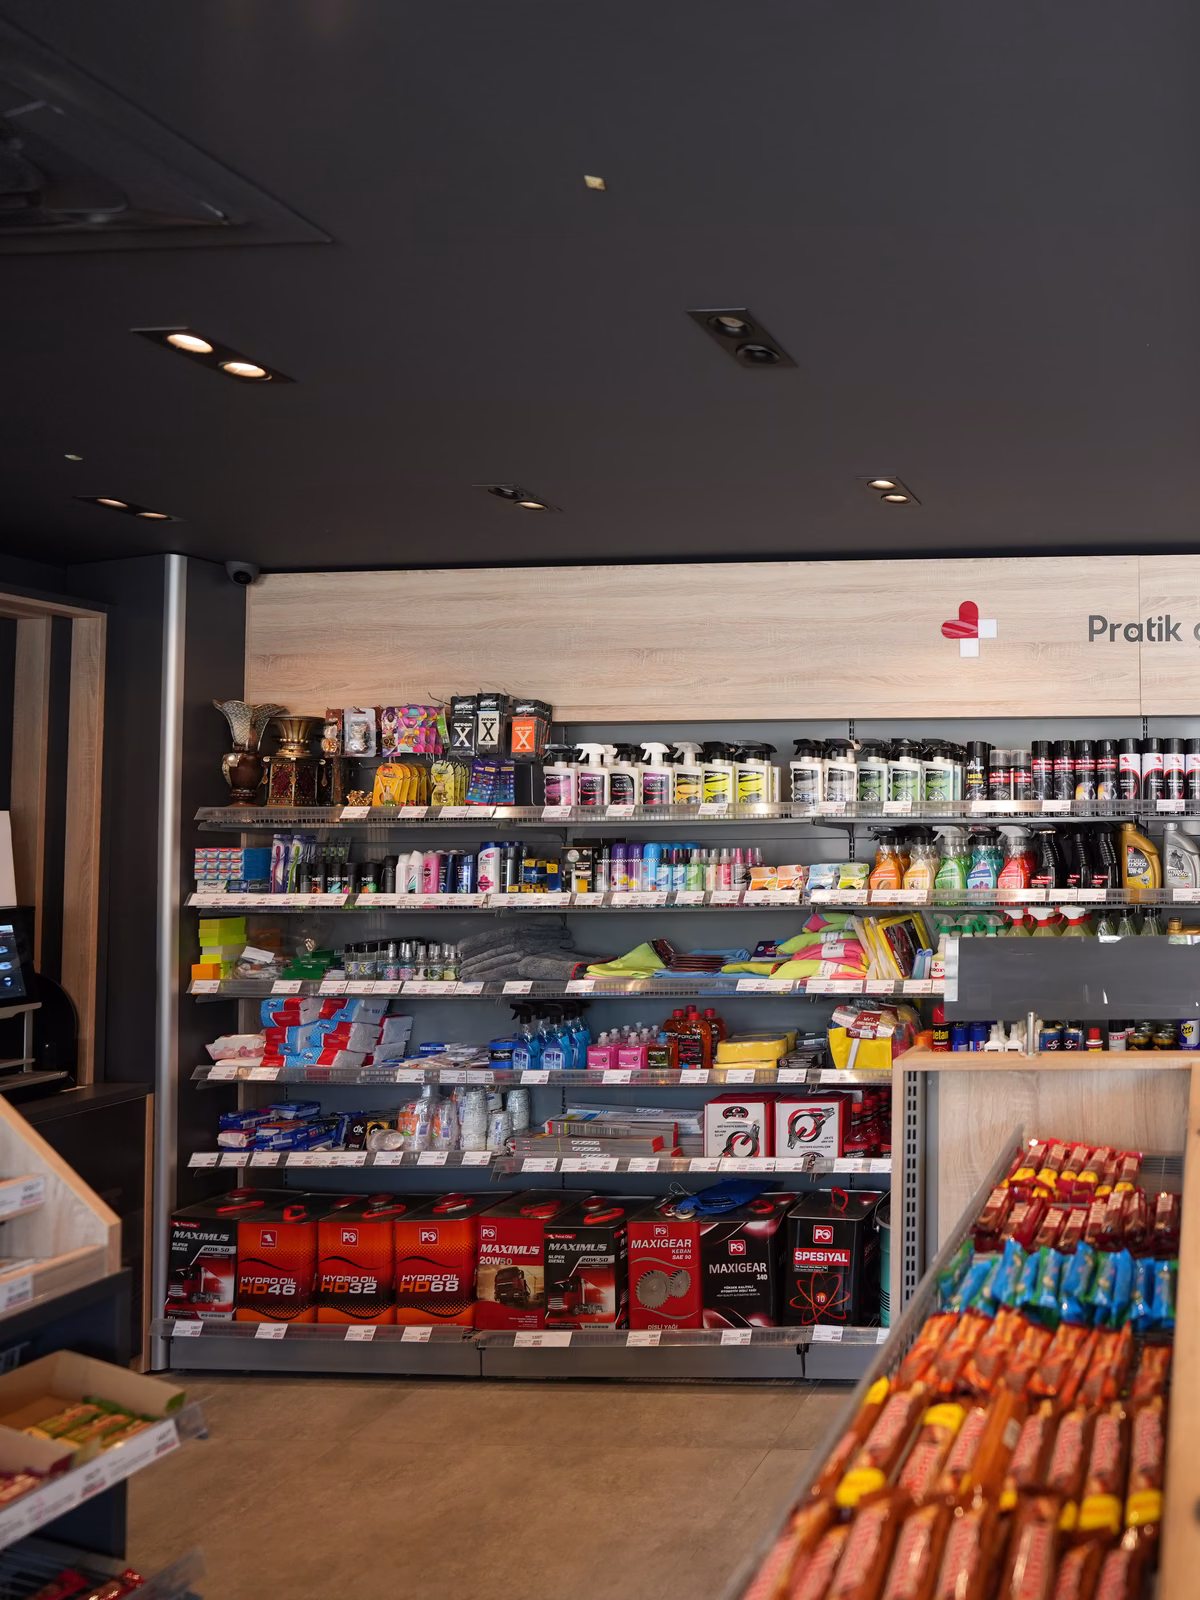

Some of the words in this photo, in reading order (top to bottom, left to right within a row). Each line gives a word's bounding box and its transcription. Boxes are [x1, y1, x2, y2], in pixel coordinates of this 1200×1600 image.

[1088, 614, 1182, 642] Pratik
[454, 727, 472, 746] X
[480, 722, 496, 742] X
[514, 730, 532, 750] X
[932, 1030, 948, 1040] detan
[172, 1230, 230, 1242] MAXIMUS
[480, 1244, 540, 1255] MAXIMUS
[548, 1243, 607, 1252] MAXIMUS
[630, 1239, 692, 1249] MAXIGEAR
[479, 1256, 512, 1265] 20W50
[709, 1263, 767, 1274] MAXIGEAR
[238, 1283, 296, 1295] HD46
[320, 1282, 378, 1294] HD32
[400, 1281, 459, 1292] HD68
[816, 1294, 825, 1303] 10
